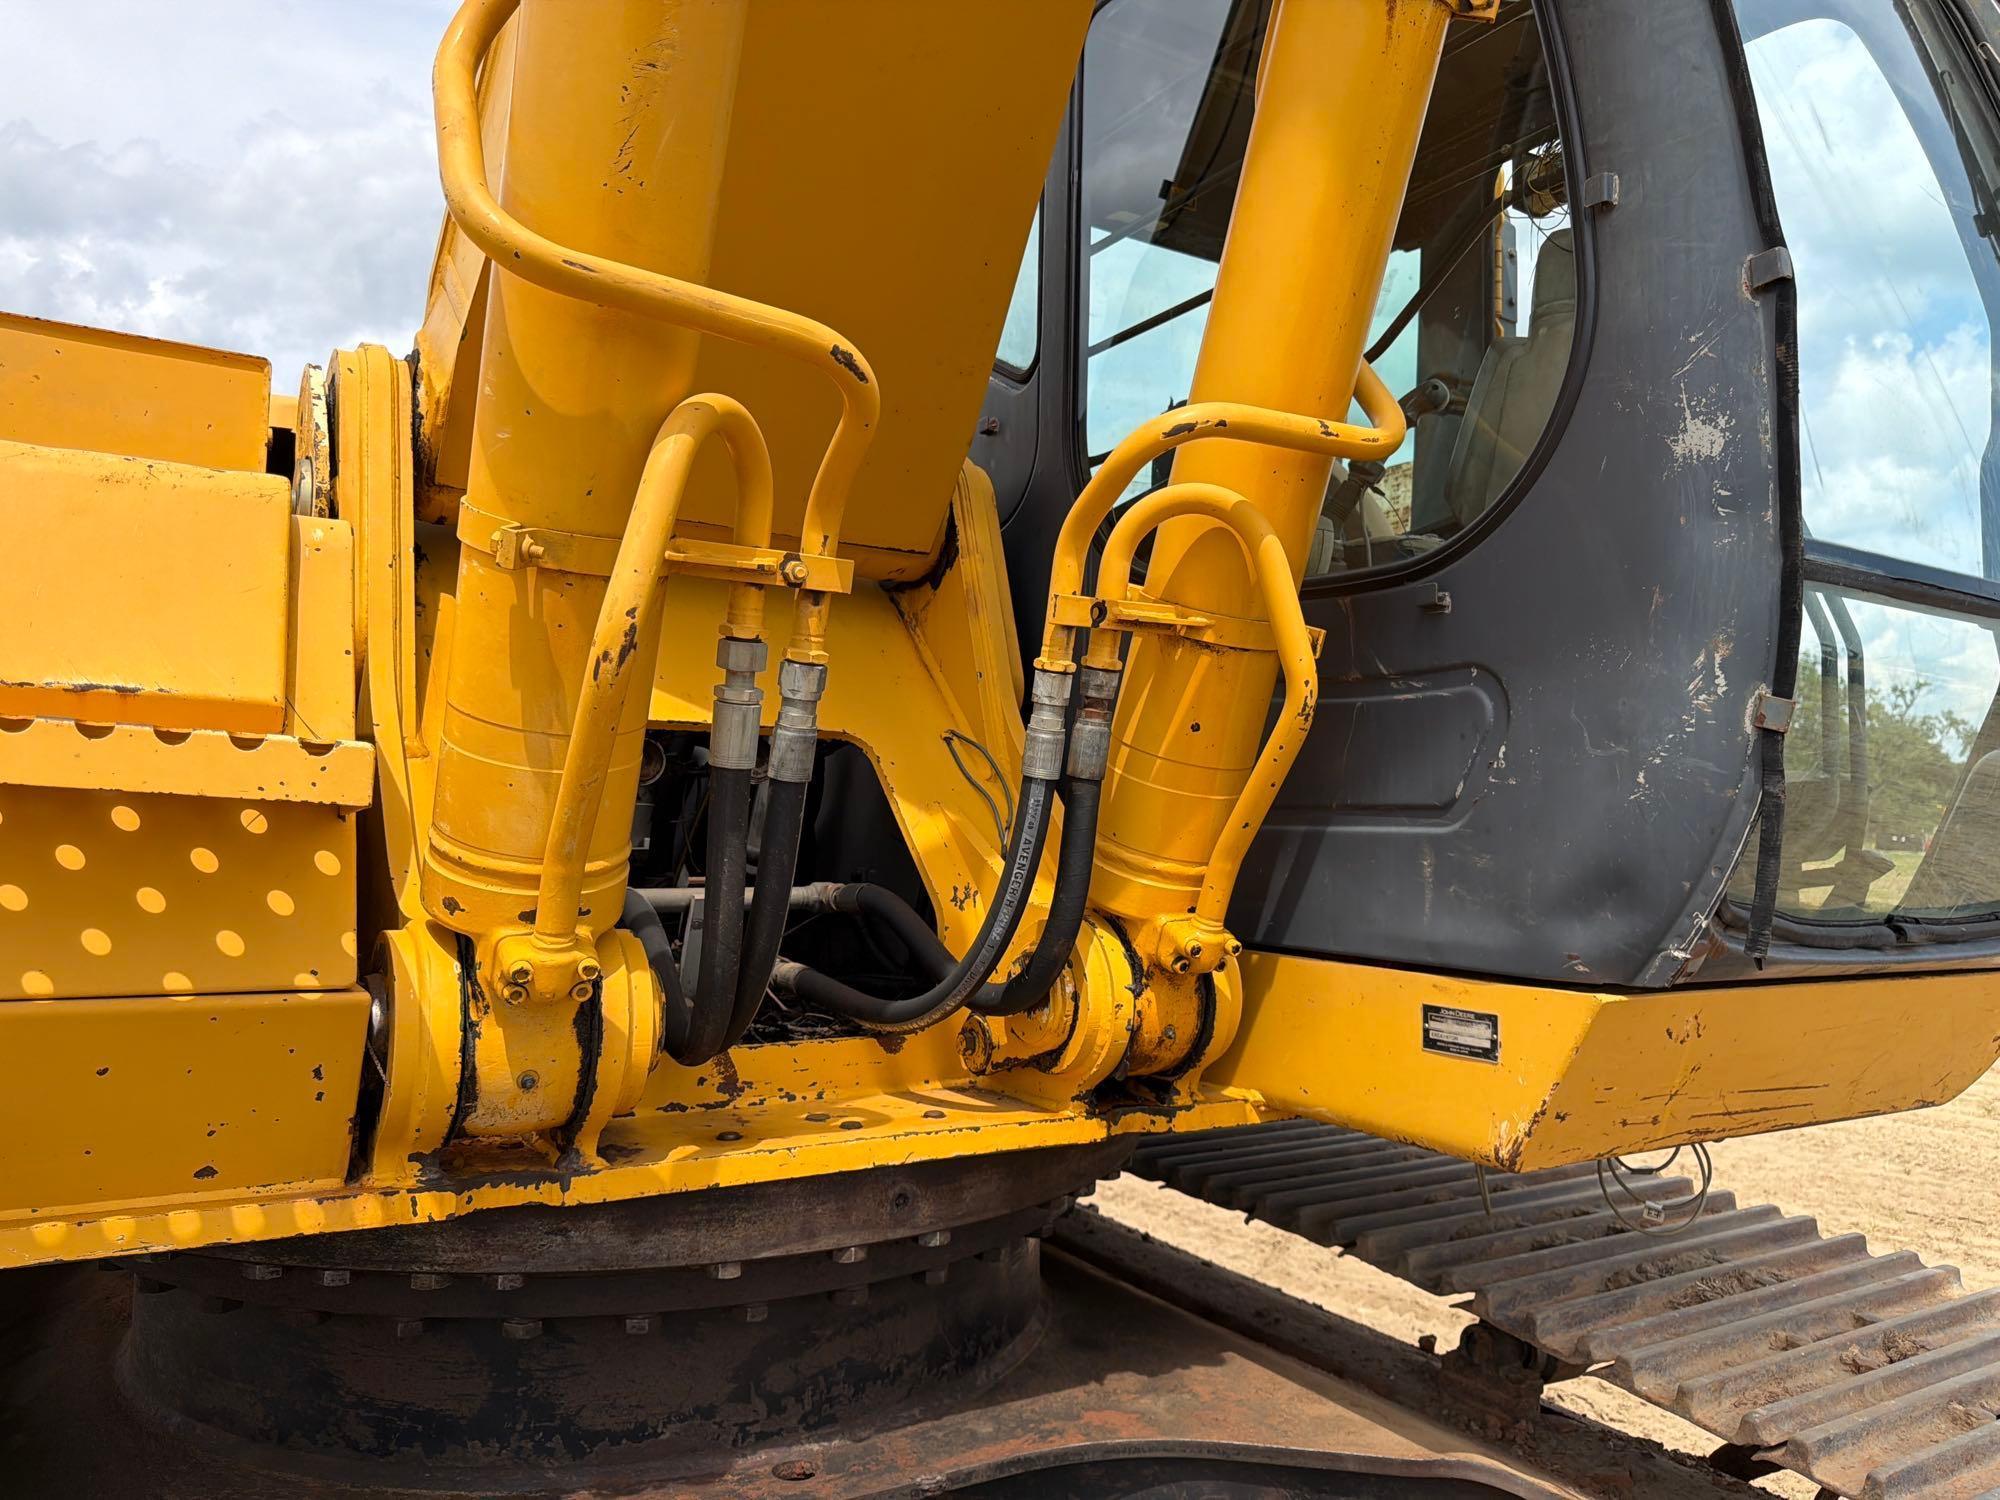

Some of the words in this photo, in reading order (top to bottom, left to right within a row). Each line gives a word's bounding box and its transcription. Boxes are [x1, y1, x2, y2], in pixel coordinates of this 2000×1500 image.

[1009, 838, 1033, 896] AVENGER
[1440, 1008, 1455, 1017] JOHN
[1455, 1010, 1475, 1020] DEERE
